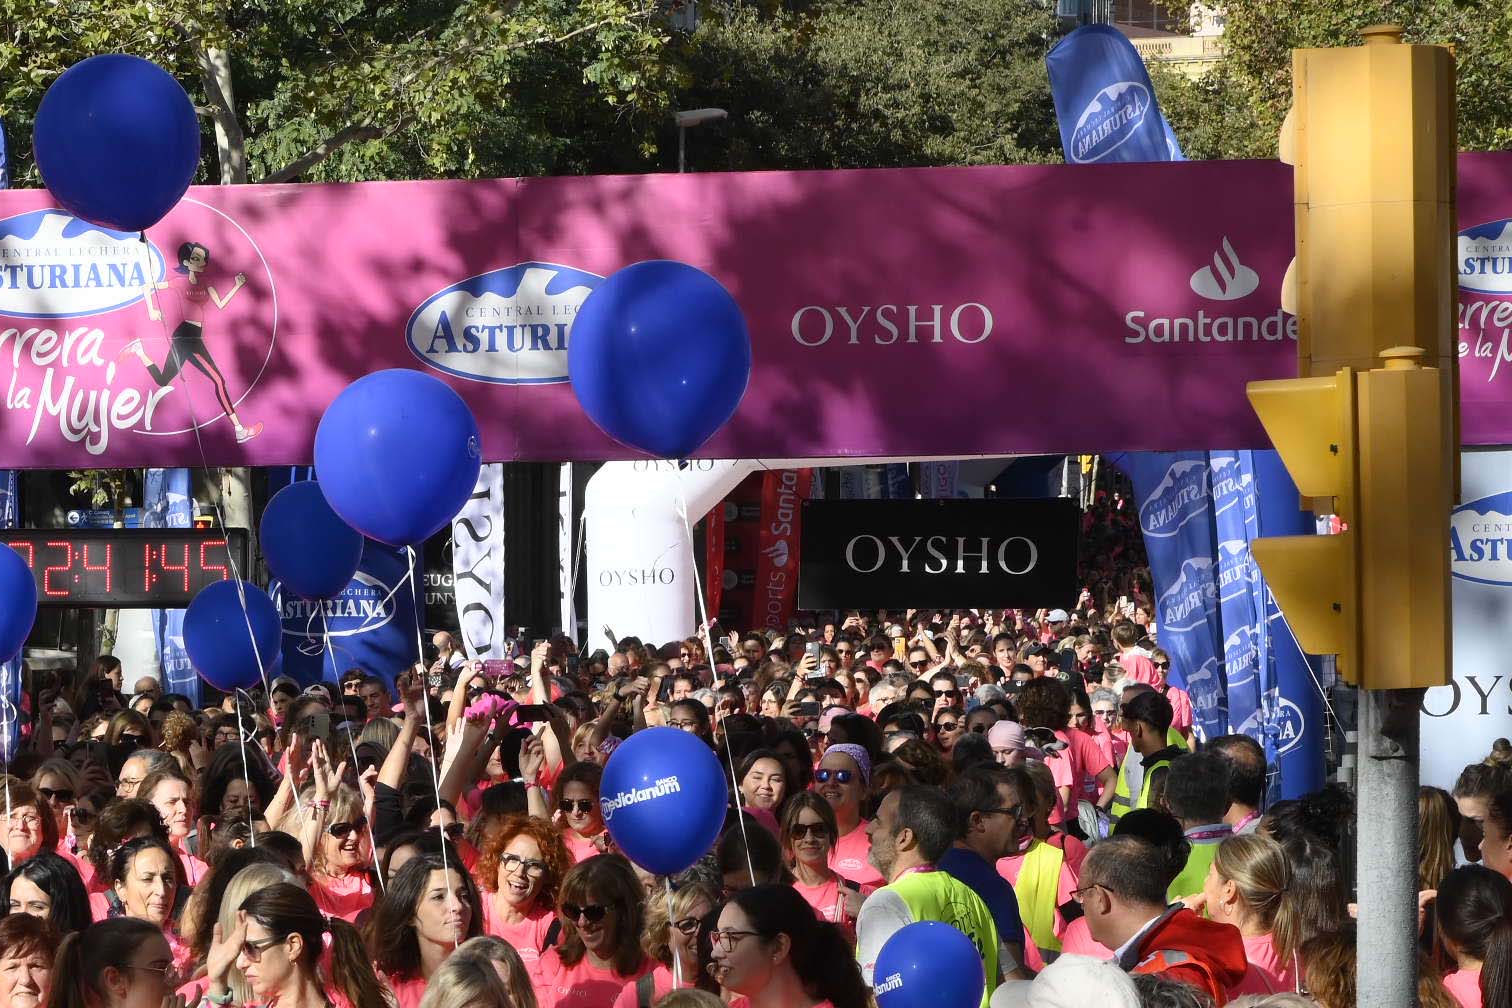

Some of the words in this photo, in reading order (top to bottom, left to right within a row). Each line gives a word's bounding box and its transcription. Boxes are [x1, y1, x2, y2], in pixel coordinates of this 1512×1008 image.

[1465, 245, 1510, 254] CENTRA
[464, 305, 543, 319] CENTRAL
[790, 302, 994, 347] OYSHO
[1124, 308, 1299, 344] Santande
[425, 310, 569, 355] ASTURI
[6, 371, 32, 410] la
[25, 361, 175, 456] Mujer
[772, 467, 798, 536] Santa
[1451, 526, 1512, 563] ASTU
[1472, 523, 1512, 534] CENT
[845, 534, 1039, 575] OYSHO
[599, 567, 676, 587] OYSHO
[600, 779, 681, 818] mediolanum
[655, 775, 679, 787] BANCO
